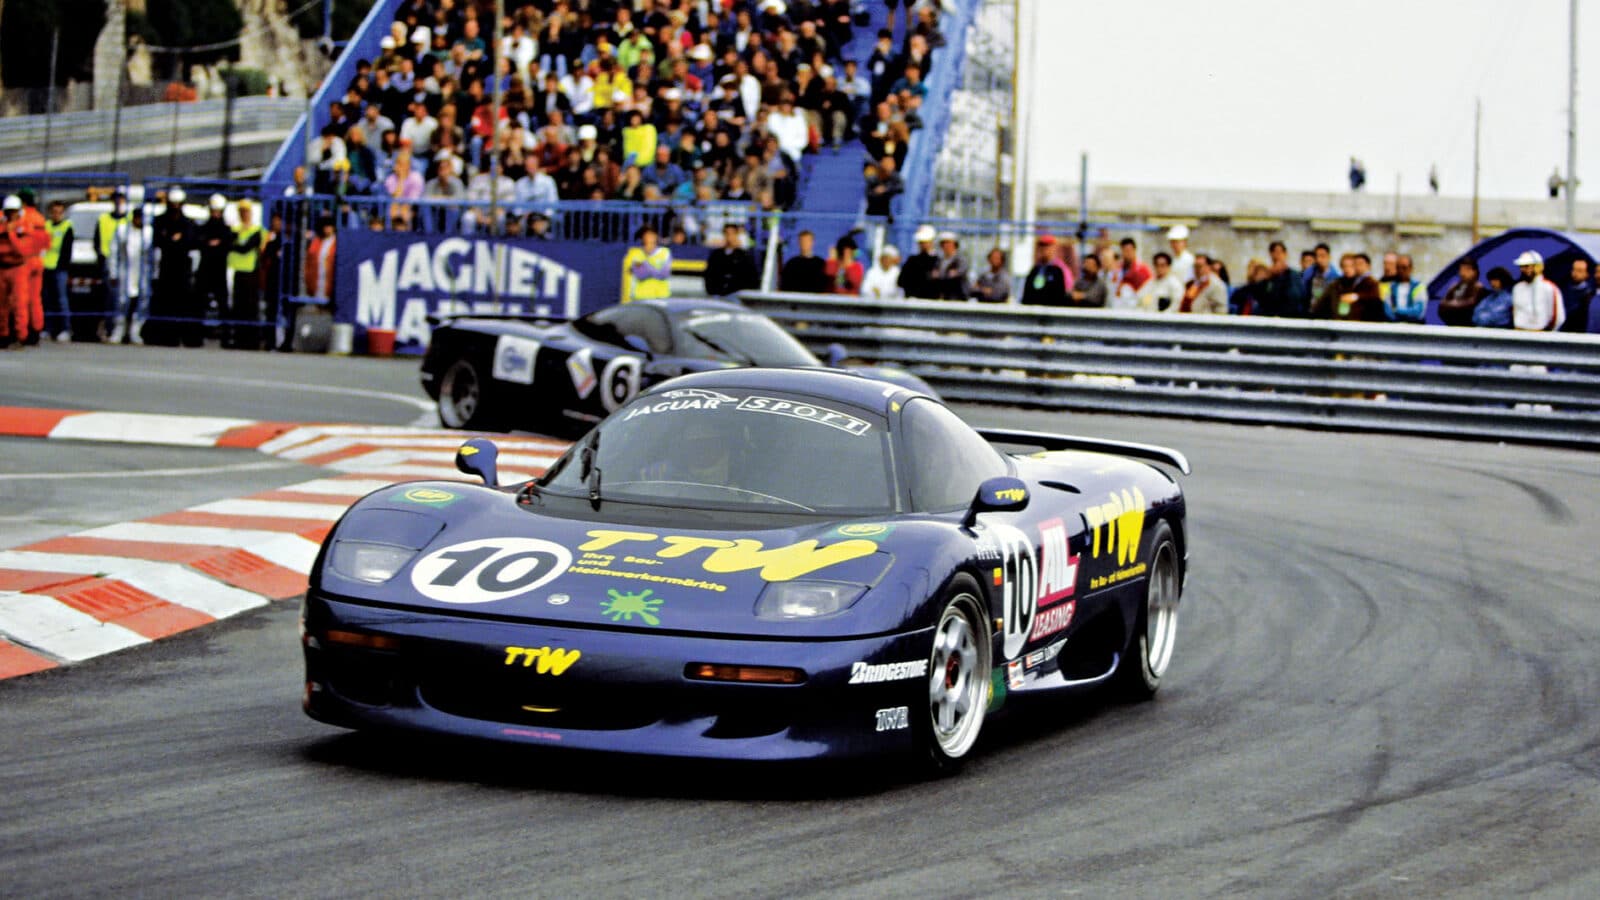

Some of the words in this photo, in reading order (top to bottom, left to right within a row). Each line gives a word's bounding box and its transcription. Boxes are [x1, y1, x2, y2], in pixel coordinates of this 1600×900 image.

[357, 237, 581, 331] MAGNETI
[612, 364, 631, 404] 6
[624, 398, 721, 421] JAGUAR
[745, 398, 865, 430] SPORT
[995, 489, 1026, 501] TTW
[1086, 485, 1145, 567] TTW
[430, 546, 558, 593] 10
[578, 530, 878, 582] TTW
[1006, 540, 1033, 634] 10
[1031, 603, 1073, 640] LEASING
[503, 646, 581, 676] TTW
[848, 659, 929, 684] BRIDGESTONE
